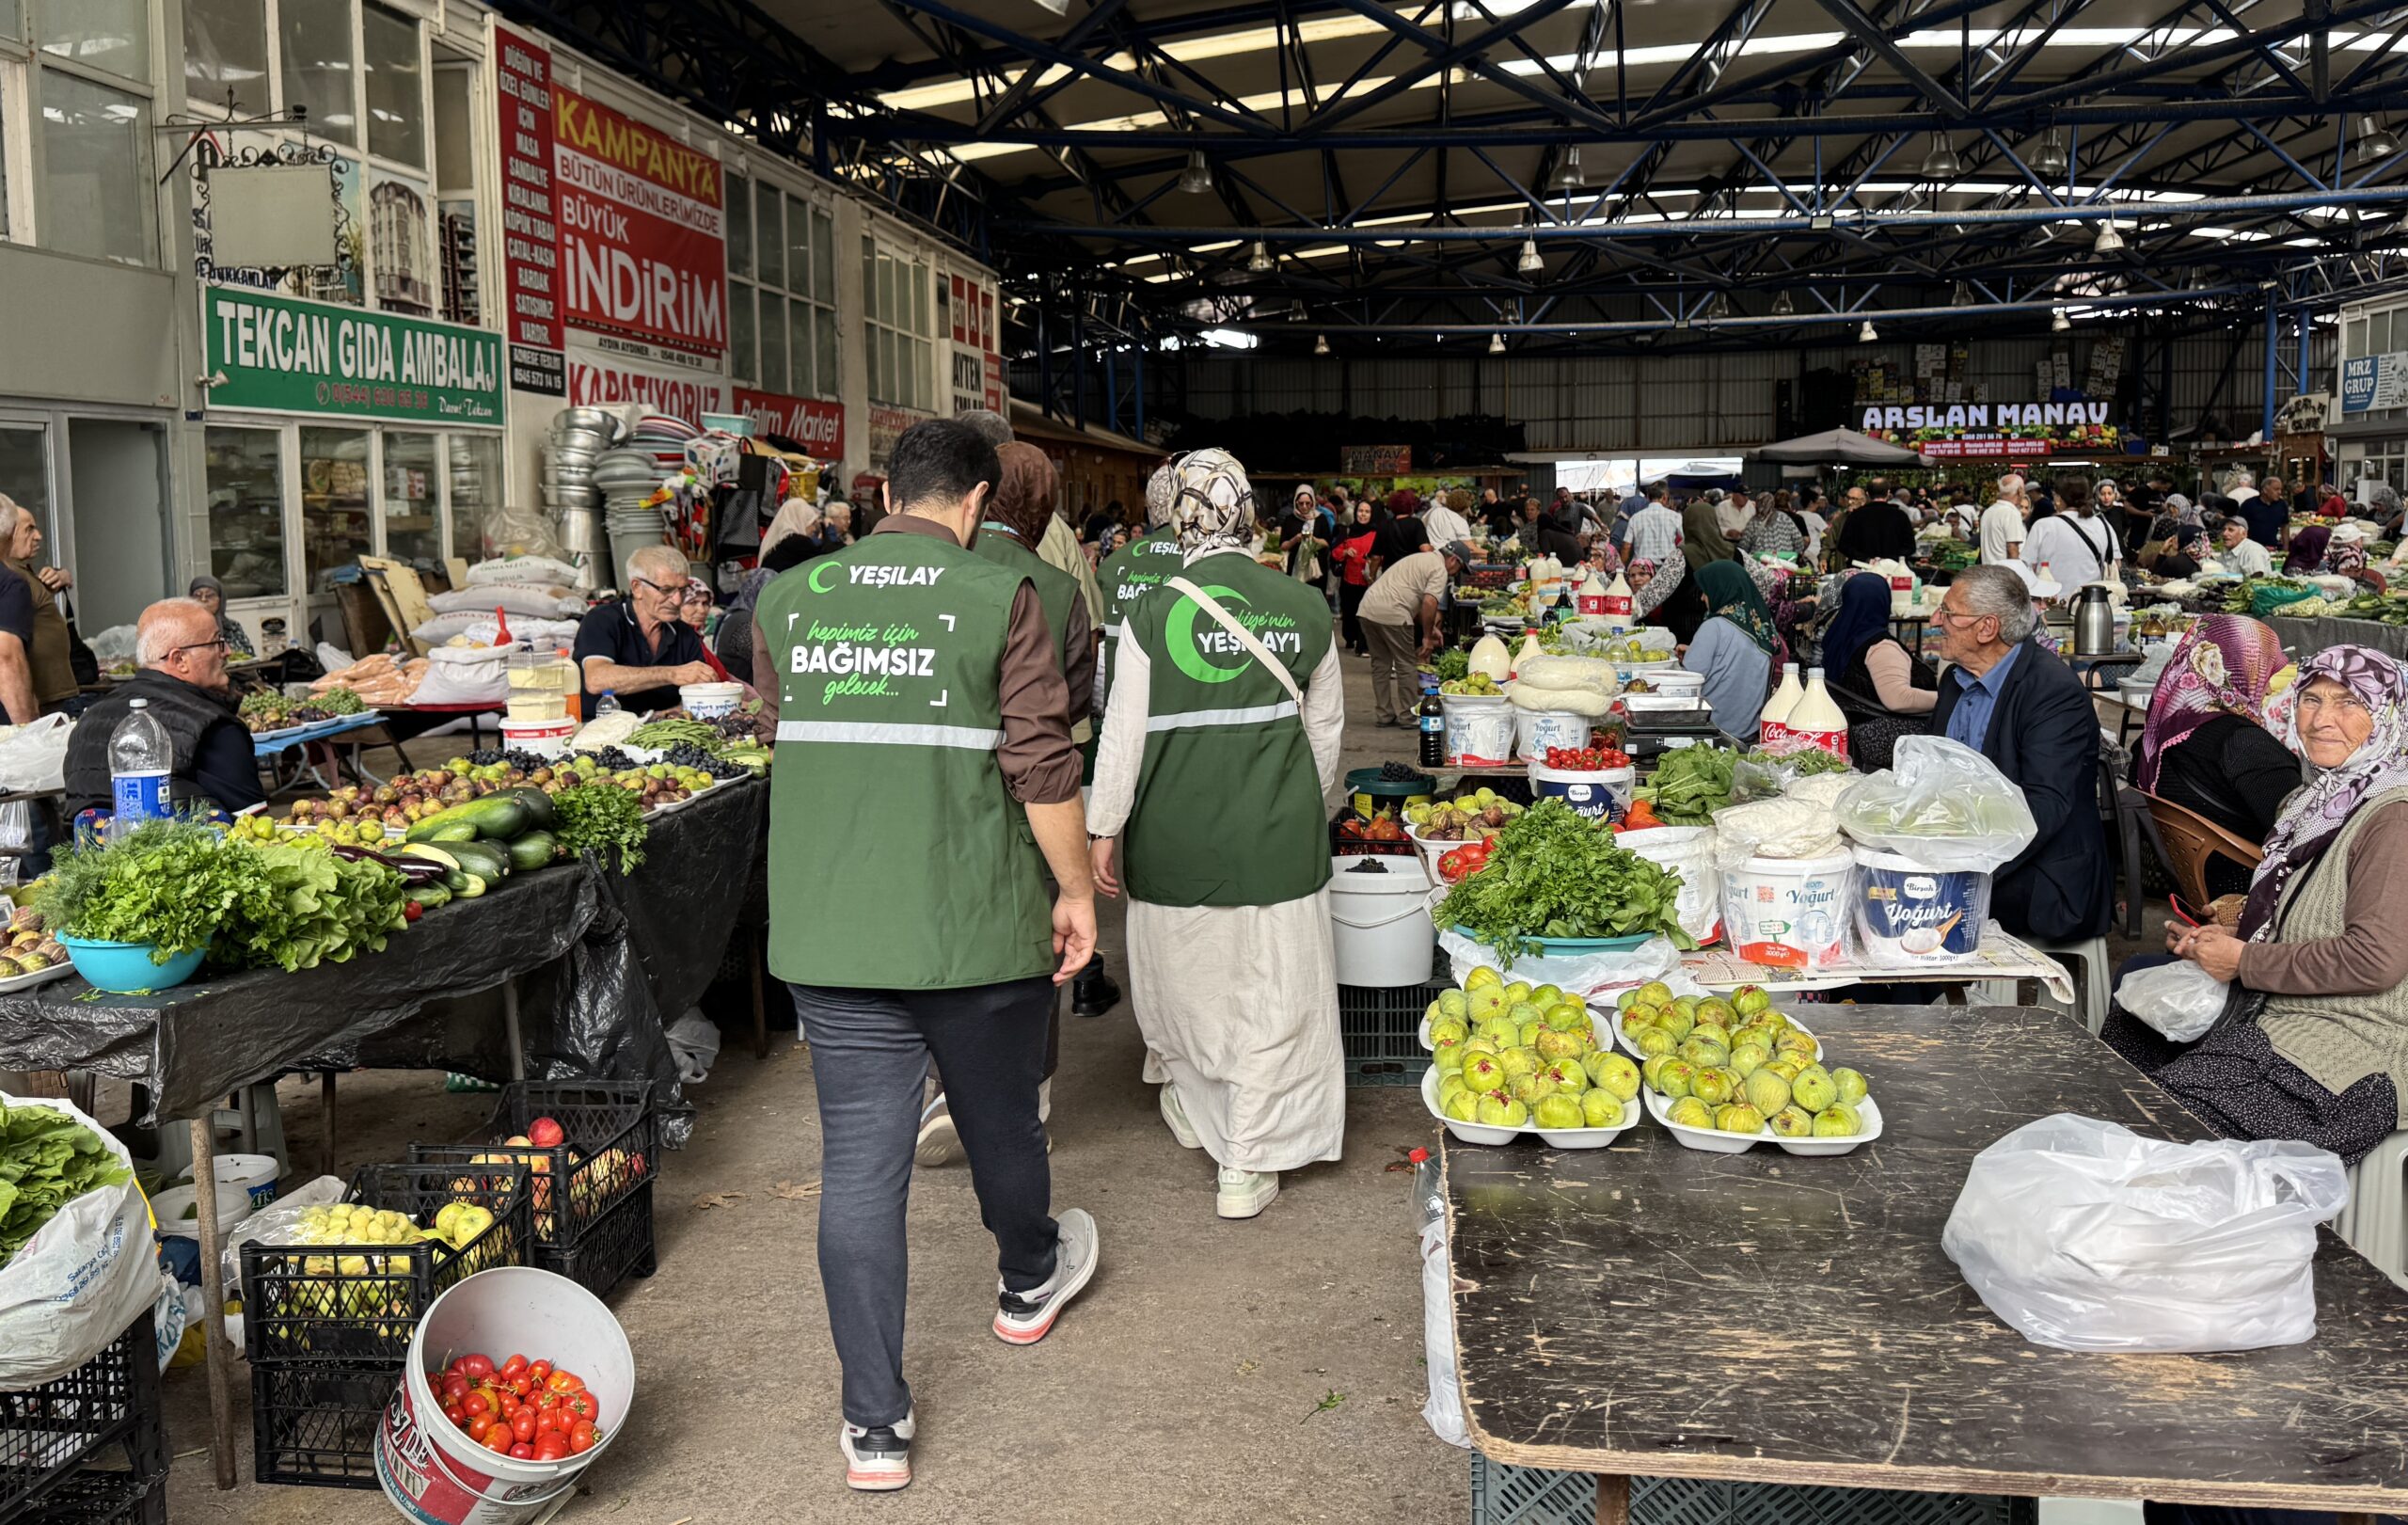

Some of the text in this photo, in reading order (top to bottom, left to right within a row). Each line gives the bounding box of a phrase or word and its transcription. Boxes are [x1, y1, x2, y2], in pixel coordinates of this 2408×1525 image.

[556, 91, 718, 203] KAMPANYA
[560, 154, 719, 235] BÜTÜN ÜRÜNLERİMİZDE
[562, 194, 629, 245] BÜYÜK
[518, 266, 549, 293] BARDAK
[564, 232, 723, 342] İNDİRİM
[216, 299, 330, 376] TEKCAN
[339, 319, 396, 382] GIDA
[402, 328, 497, 393] AMBALAJ
[598, 337, 620, 351] AYDIN
[953, 351, 981, 392] AYTEN
[2347, 358, 2372, 377] MRZ
[2344, 376, 2374, 394] GRUP
[785, 403, 839, 443] Market
[1862, 402, 2109, 429] ARSLAN MANAV
[1351, 450, 1401, 460] MANAV
[1149, 541, 1183, 555] YEŞIL
[1127, 569, 1161, 585] hepimiz
[806, 619, 920, 648] hepimiz için
[1197, 630, 1301, 656] YEŞAY'I
[790, 642, 937, 676] BAĞIMSIZ
[1576, 802, 1605, 818] ğurt
[1786, 888, 1835, 908] Yoğurt
[1885, 901, 1953, 927] Yoğurt
[68, 1257, 97, 1281] Sakarya
